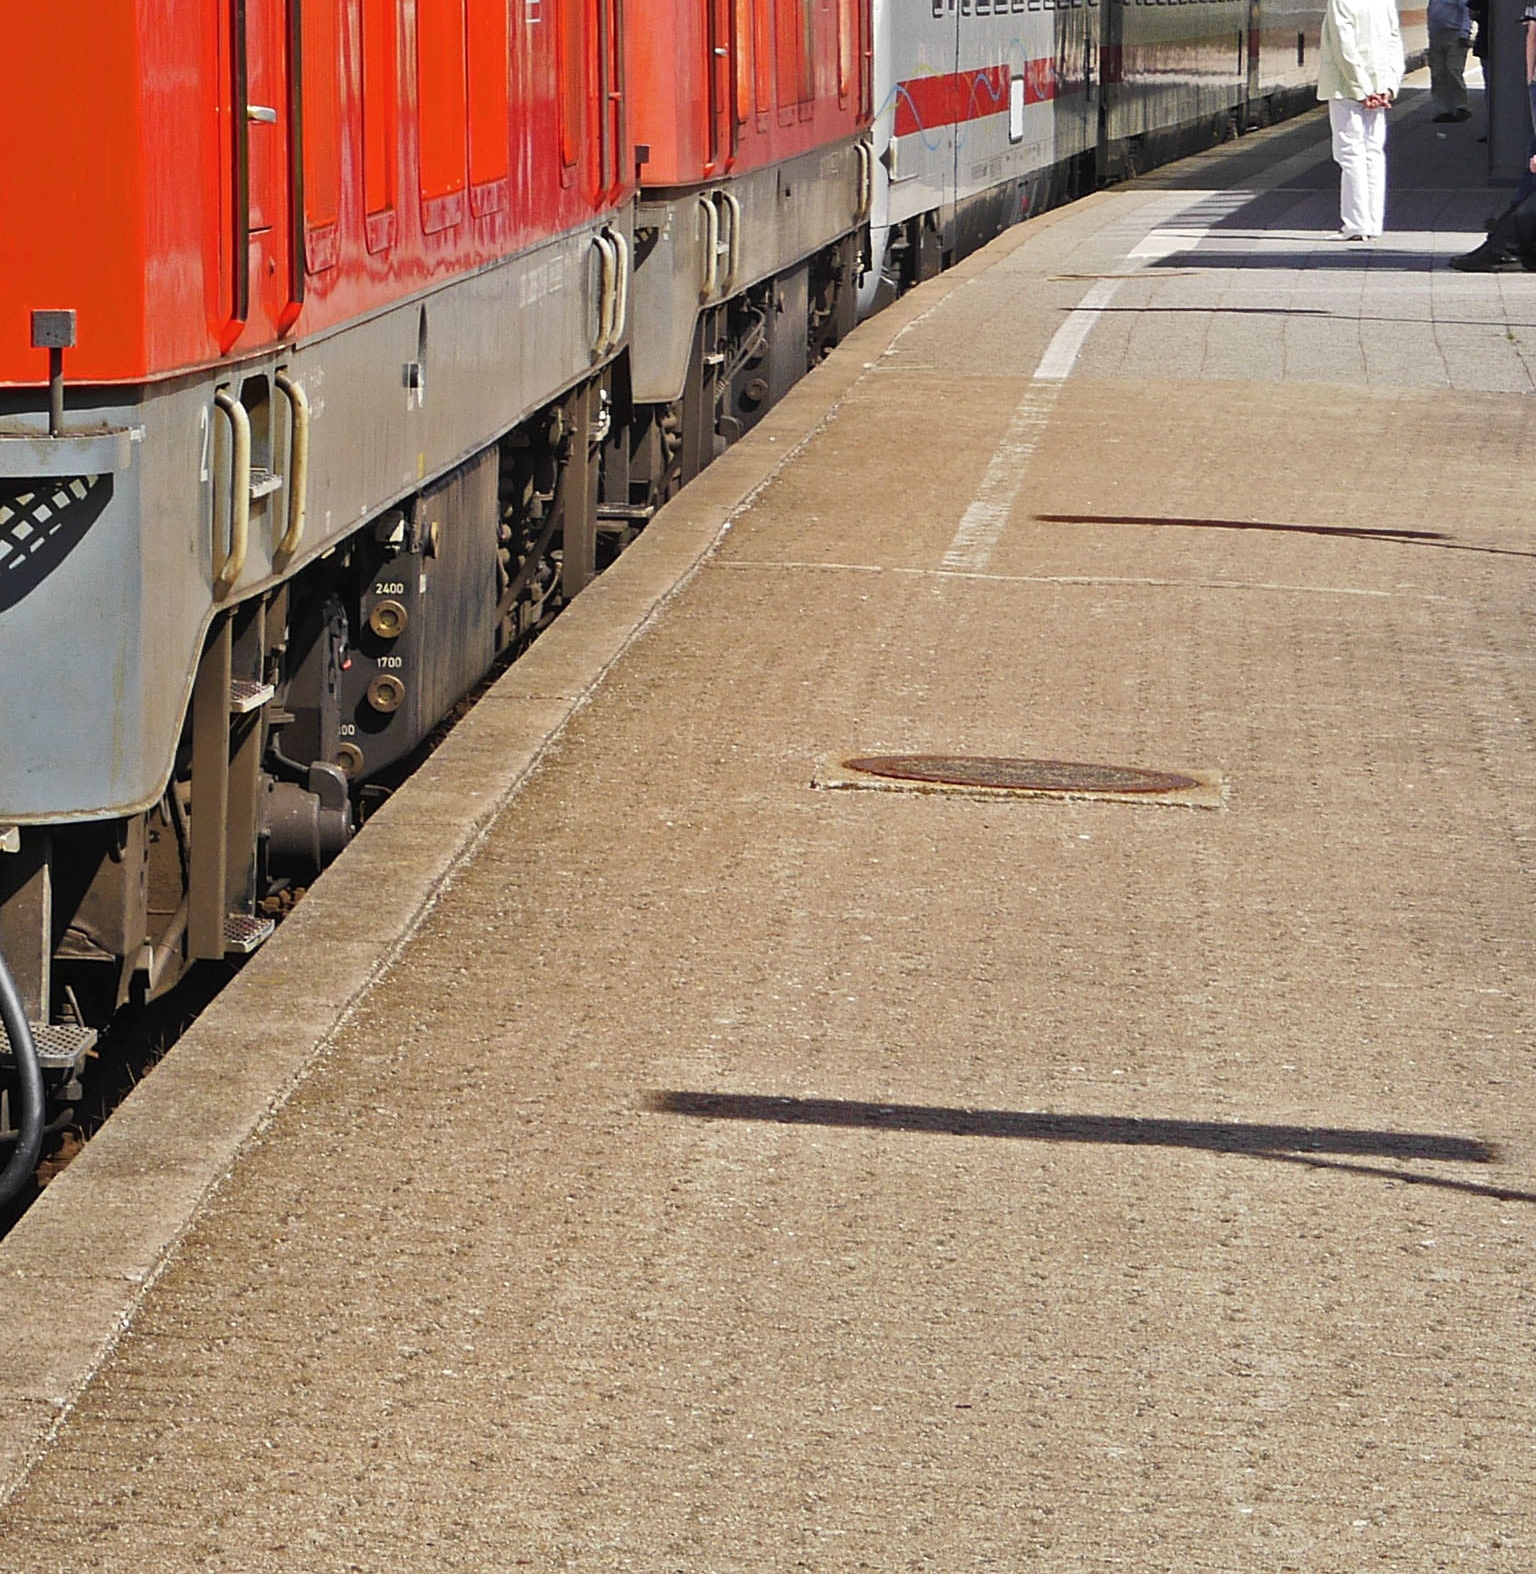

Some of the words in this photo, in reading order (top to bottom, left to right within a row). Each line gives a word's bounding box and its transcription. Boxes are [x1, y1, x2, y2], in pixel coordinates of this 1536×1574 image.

[375, 583, 404, 594] 2400
[377, 657, 402, 668] 1700
[338, 724, 355, 735] 00
